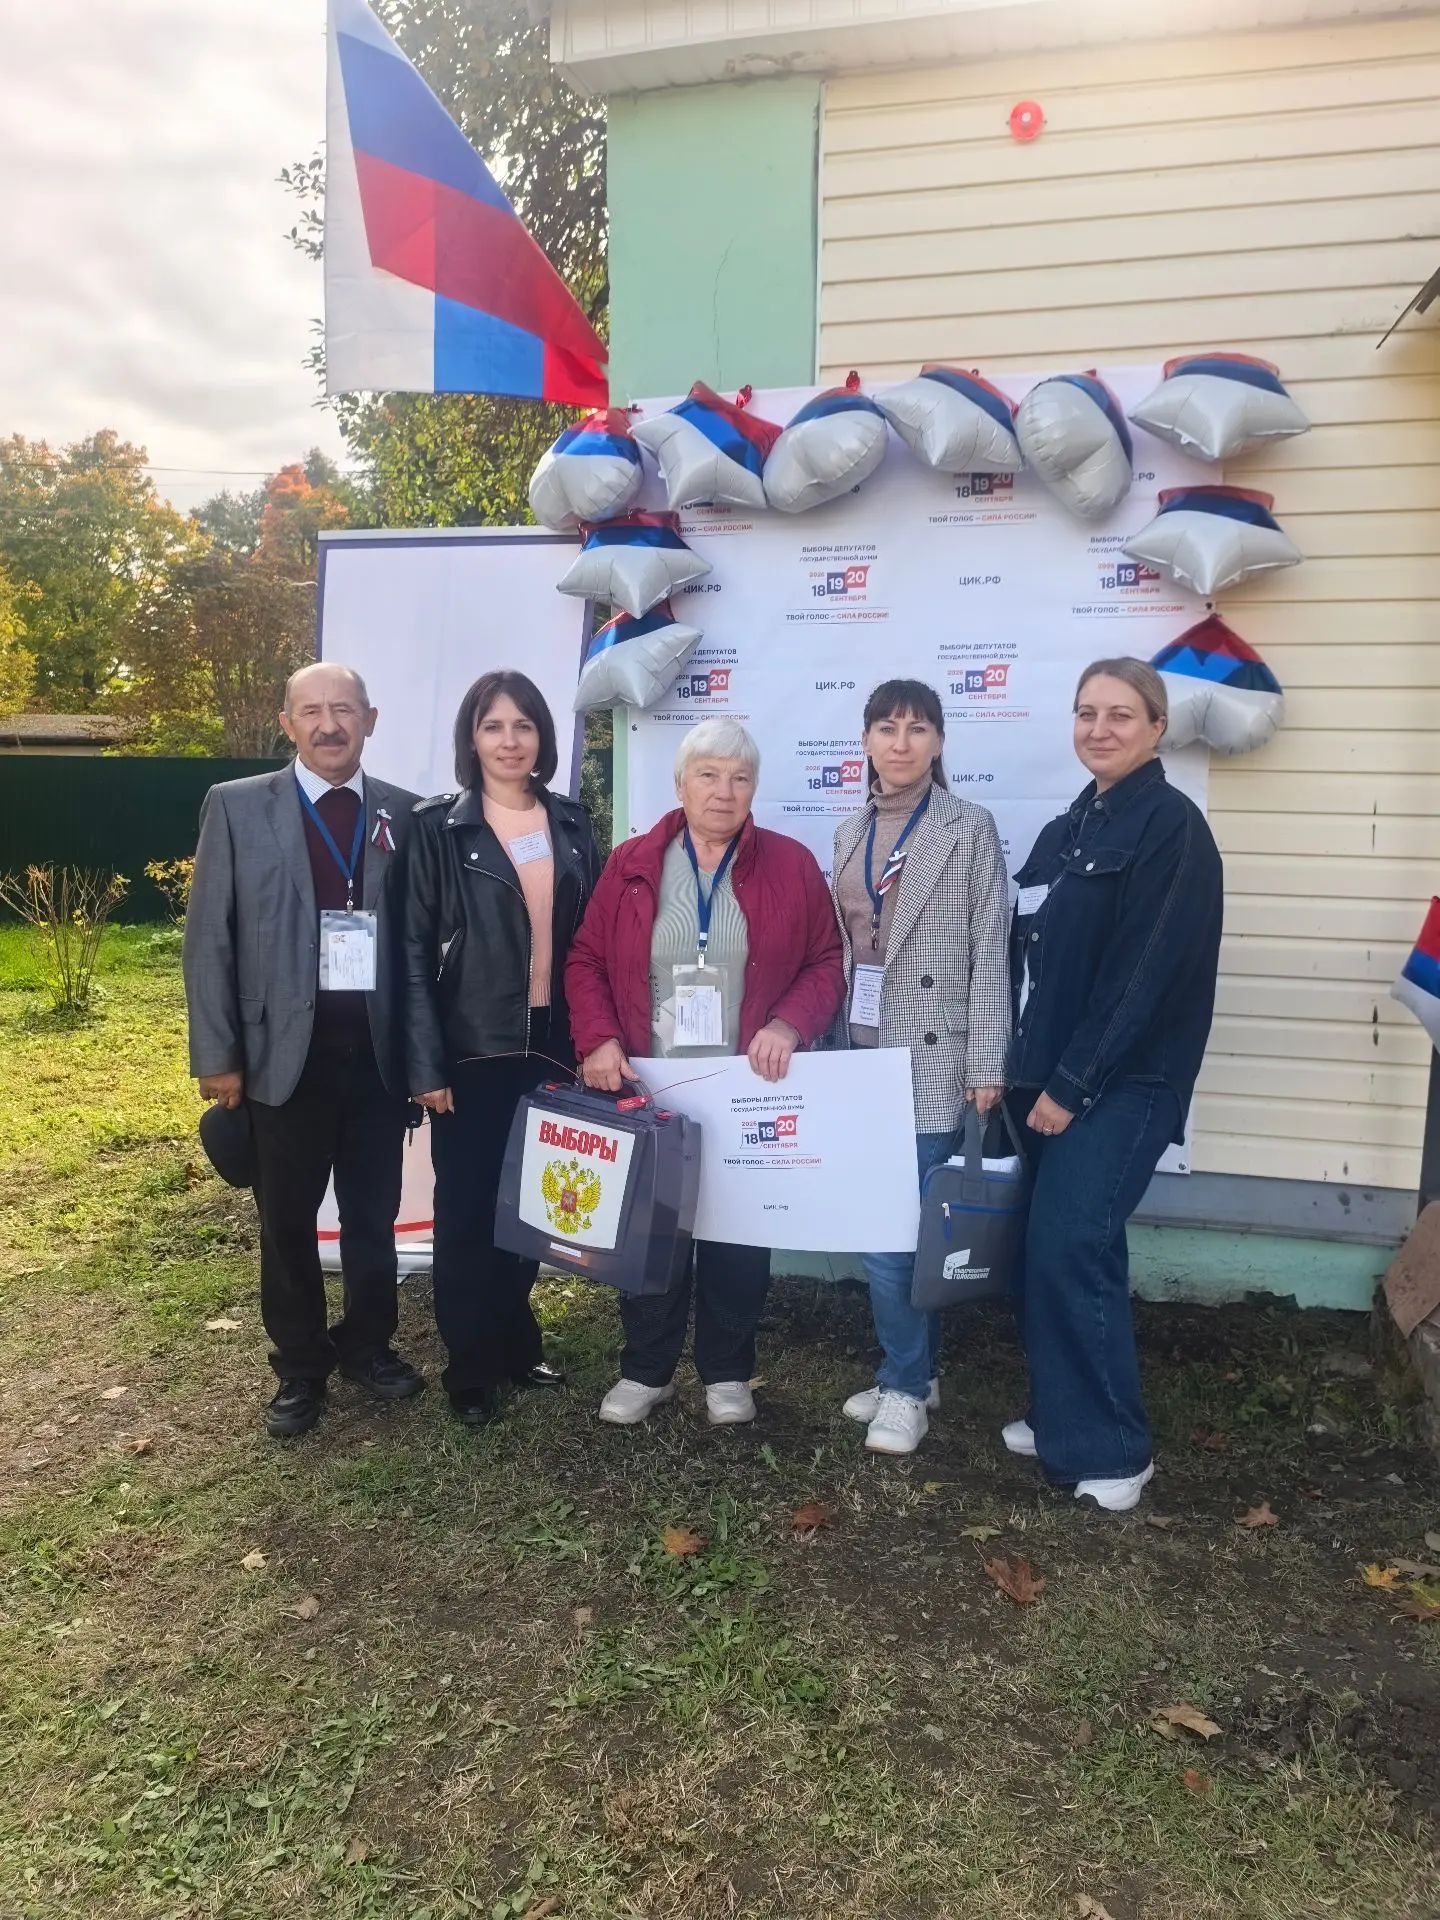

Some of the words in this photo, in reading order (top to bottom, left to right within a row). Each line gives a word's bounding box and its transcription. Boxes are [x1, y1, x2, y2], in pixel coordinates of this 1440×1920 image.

[956, 486, 970, 498] 18
[974, 478, 989, 491] 19
[928, 515, 947, 523] ТВОЙ
[834, 545, 876, 553] ДЕПУТАТОВ
[684, 584, 722, 593] ЦИК.РФ
[812, 585, 826, 597] 18
[828, 578, 843, 590] 19
[847, 571, 865, 584] 20
[960, 576, 1001, 586] ЦИК.РФ
[1100, 577, 1115, 589] 18
[1119, 569, 1135, 582] 19
[677, 687, 690, 698] 18
[693, 680, 707, 692] 19
[710, 674, 726, 686] 20
[816, 681, 856, 690] ЦИК.РФ
[949, 683, 964, 694] 18
[968, 676, 982, 687] 19
[987, 670, 1005, 682] 20
[808, 779, 821, 789] 18
[825, 772, 839, 783] 19
[842, 766, 860, 778] 20
[952, 774, 994, 783] ЦИК.РФ
[538, 1120, 618, 1163] ВЫБОРЫ
[744, 1134, 758, 1144] 18
[760, 1127, 774, 1138] 19
[777, 1120, 795, 1131] 20
